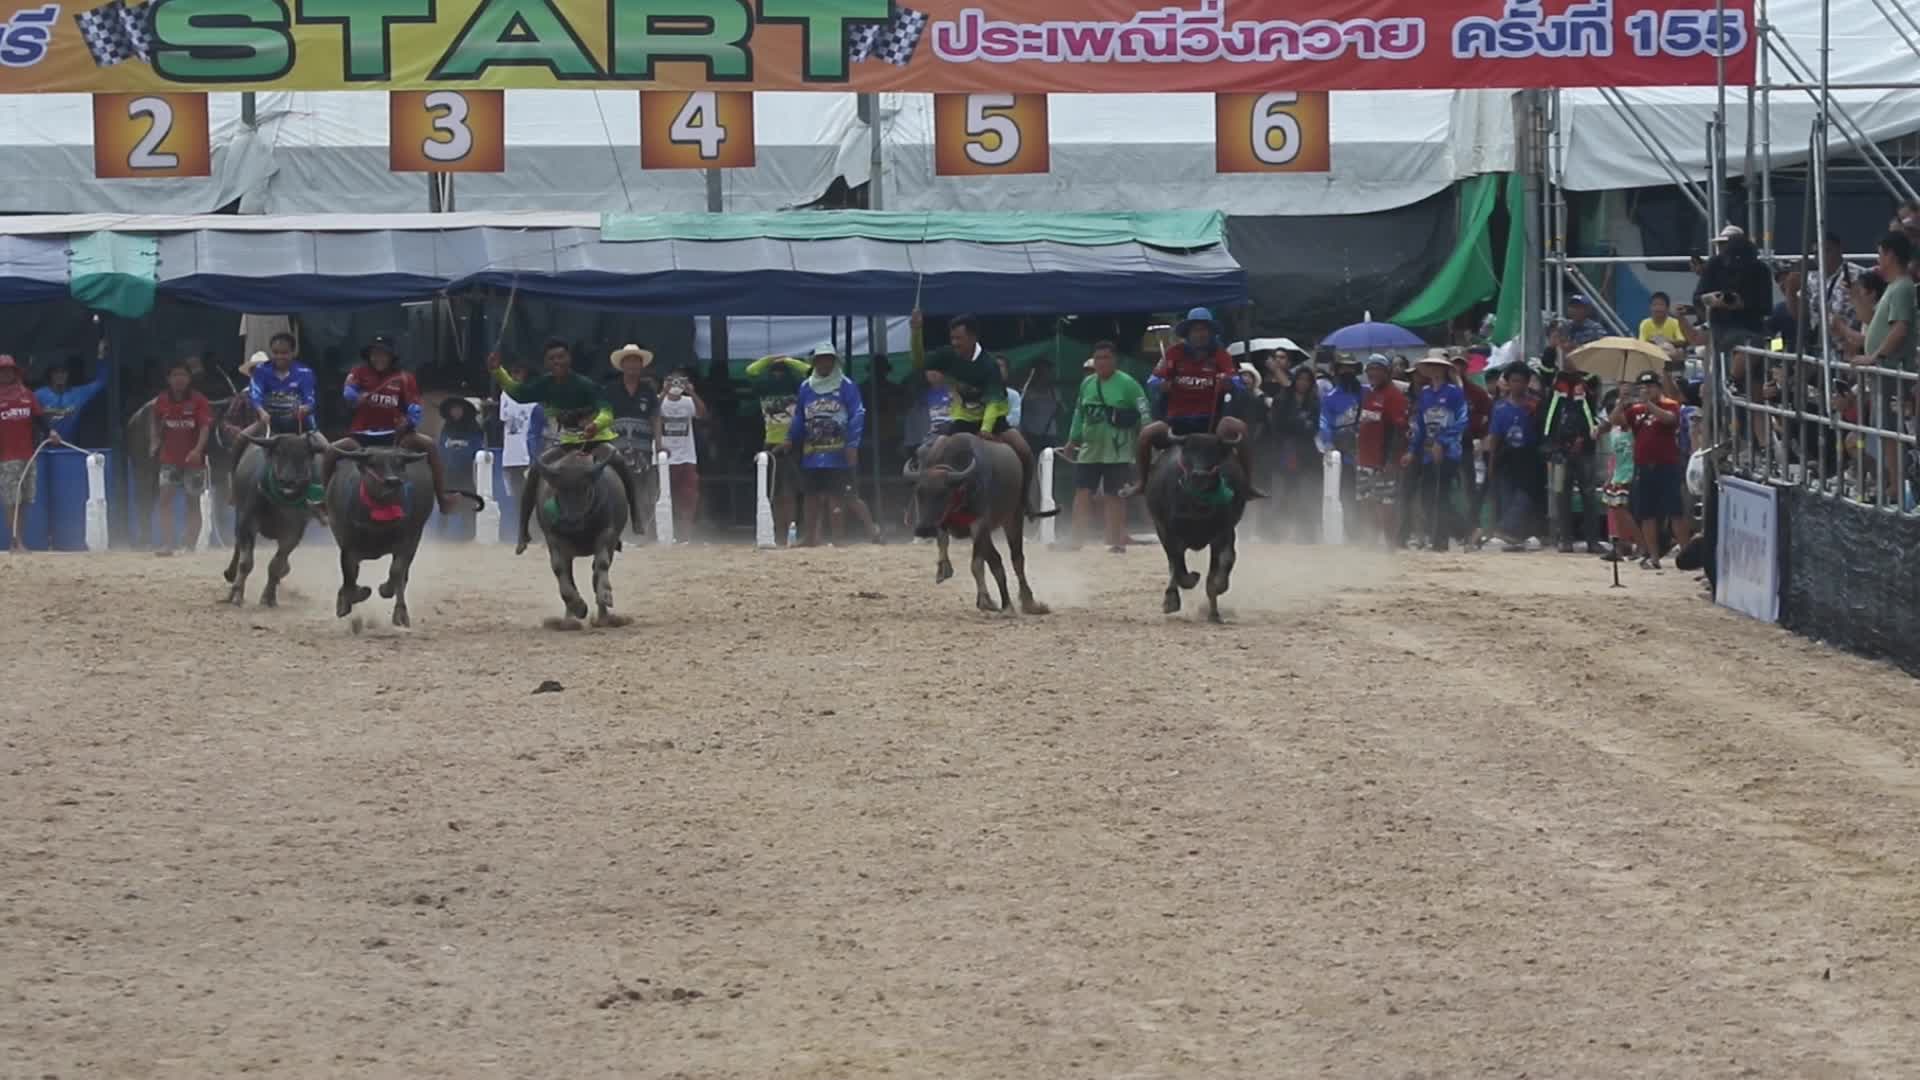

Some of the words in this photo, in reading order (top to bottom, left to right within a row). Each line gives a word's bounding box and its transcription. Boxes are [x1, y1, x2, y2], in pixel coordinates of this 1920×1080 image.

[0, 4, 60, 67] รี
[150, 0, 894, 83] START
[932, 0, 1425, 62] ประเพณีวิ่งควาย
[1452, 0, 1614, 58] ครังที
[1625, 9, 1748, 56] 155
[128, 96, 179, 170] 2
[422, 89, 474, 162] 3
[668, 90, 727, 160] 4
[964, 93, 1022, 167] 5
[1250, 91, 1303, 165] 6
